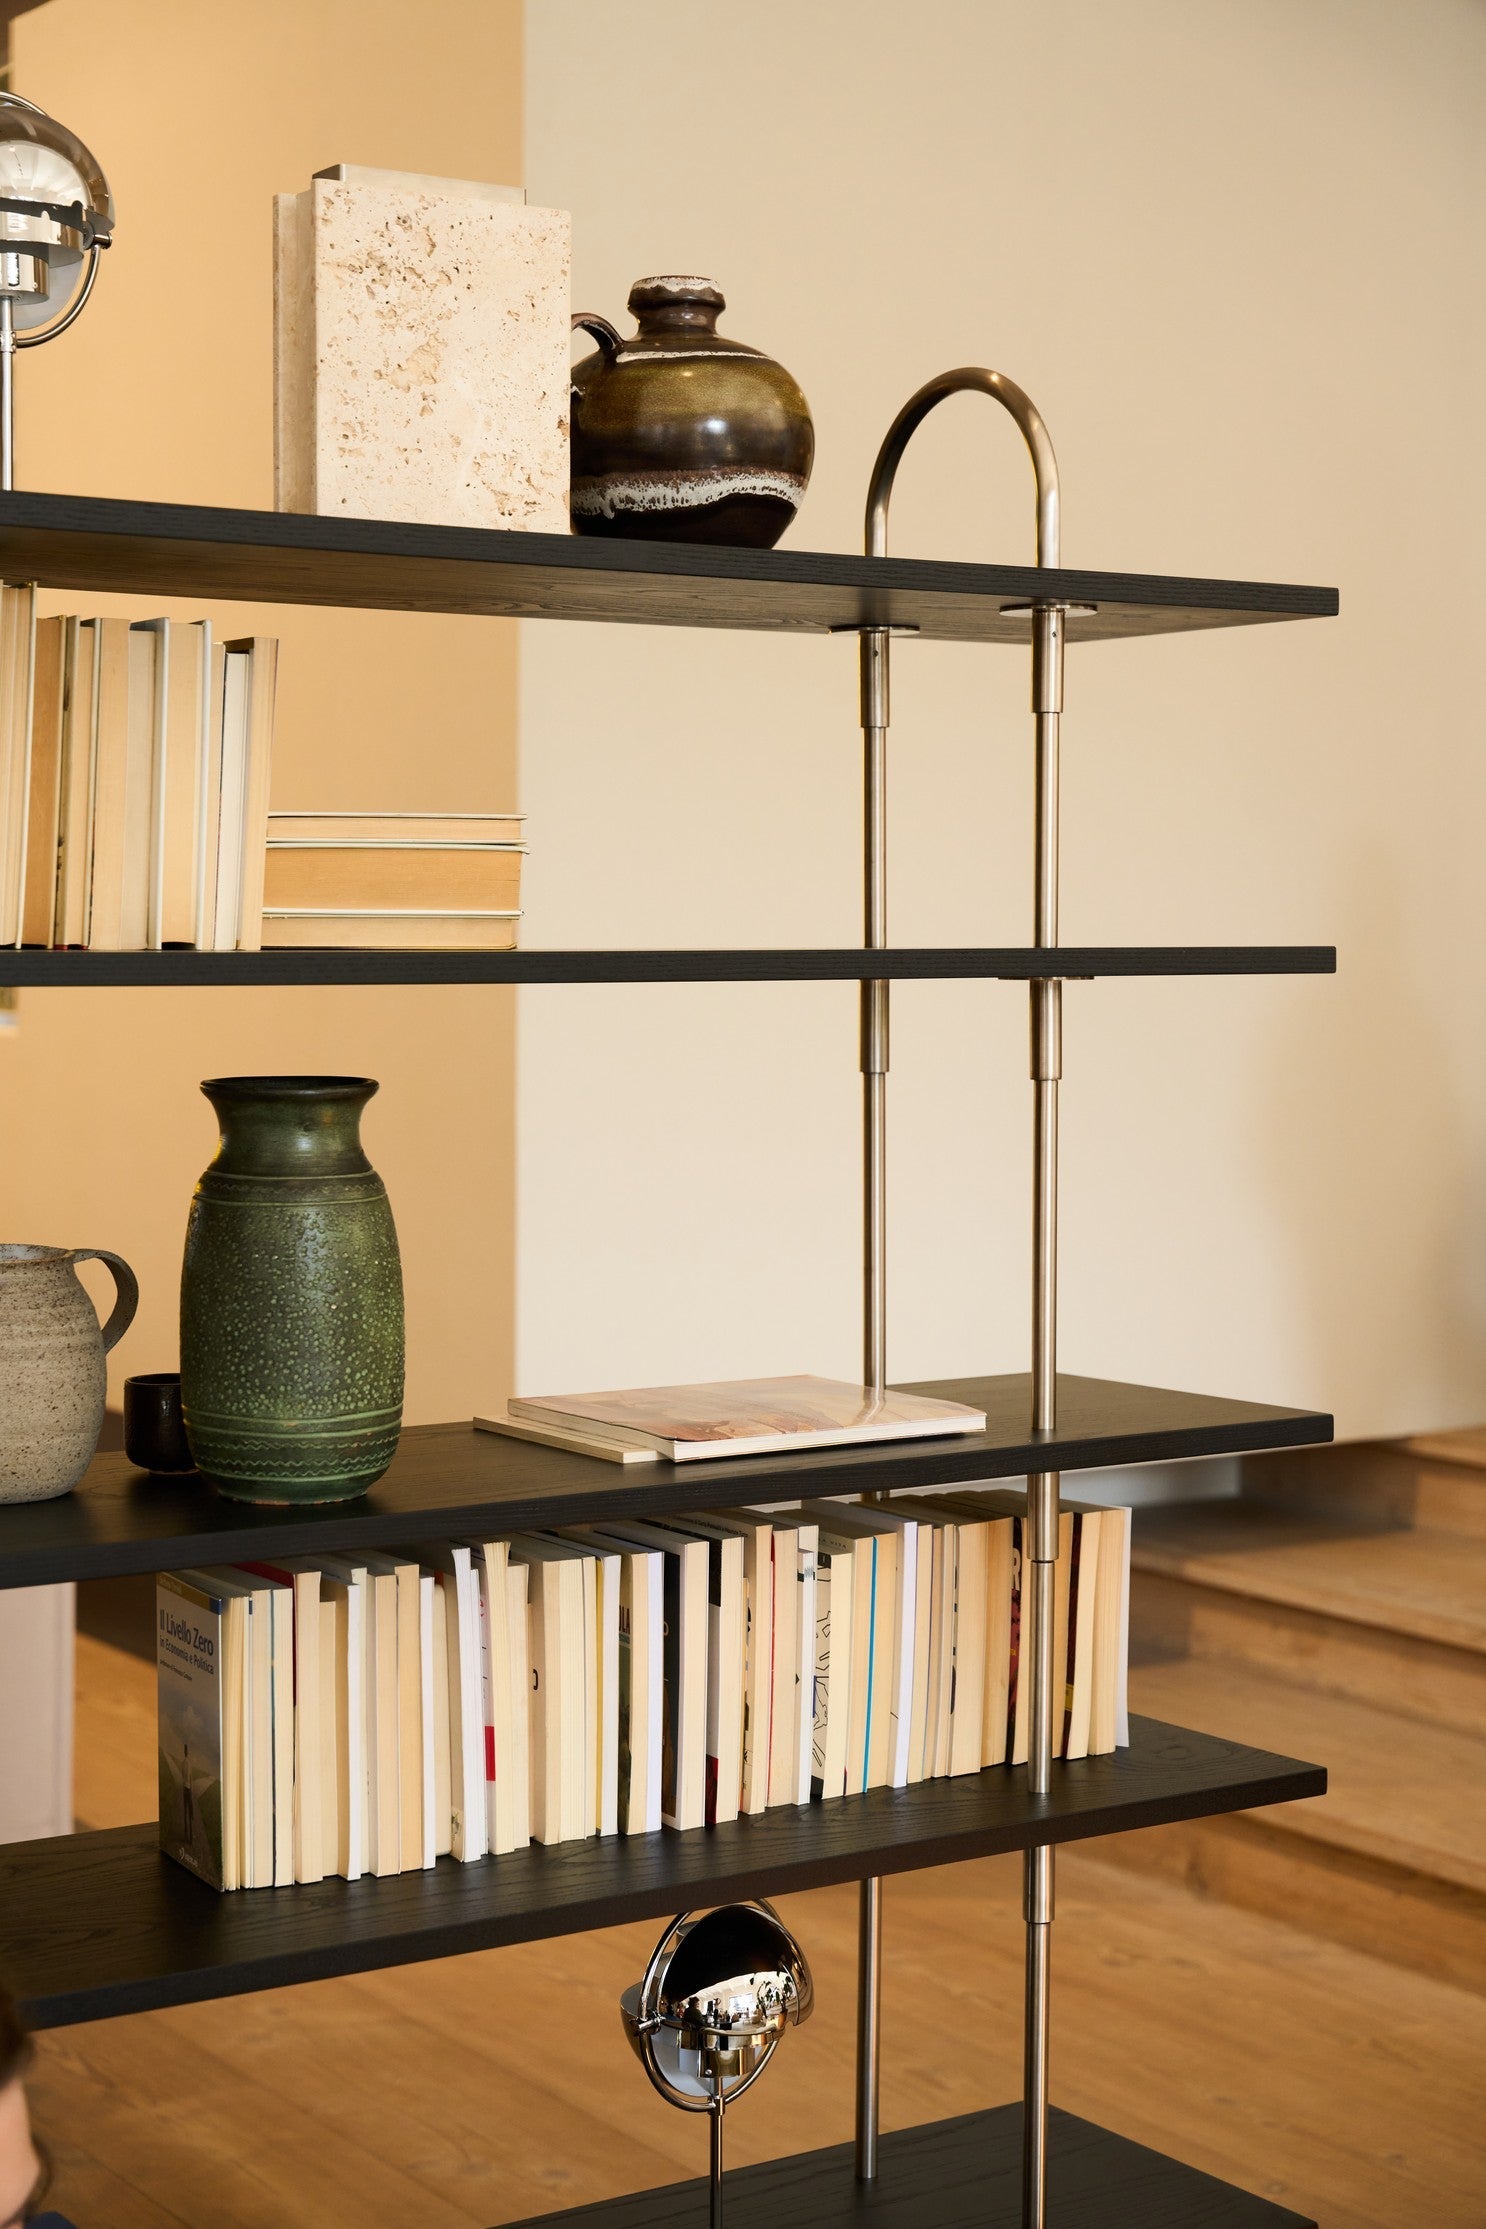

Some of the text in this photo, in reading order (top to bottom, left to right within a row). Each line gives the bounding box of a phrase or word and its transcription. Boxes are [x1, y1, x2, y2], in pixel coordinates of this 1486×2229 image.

[160, 1609, 214, 1656] Il Livello Zero
[166, 1639, 188, 1662] Economia
[194, 1654, 214, 1675] Politica
